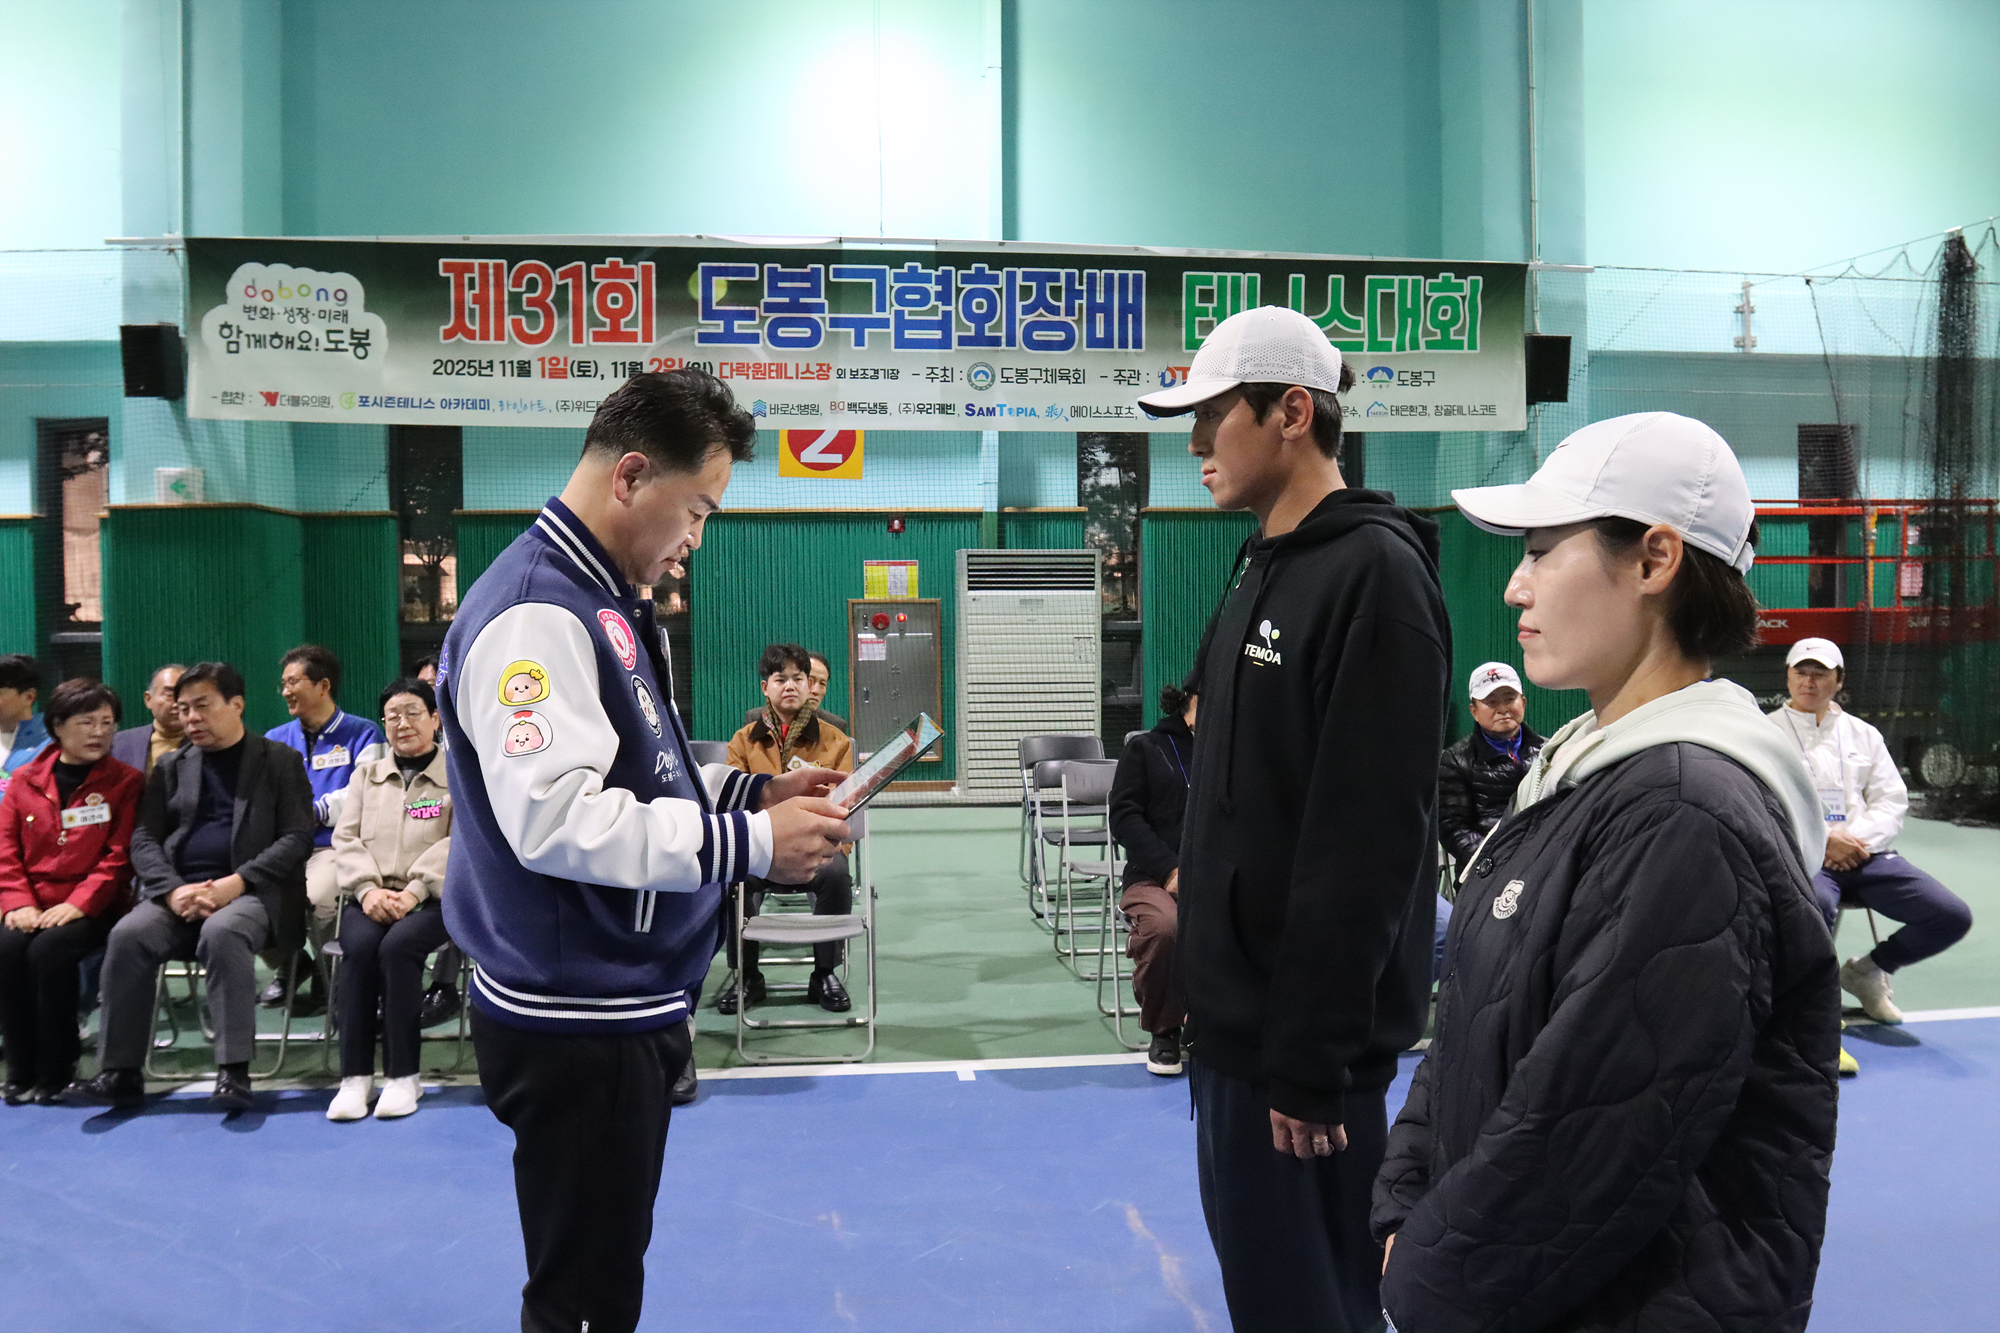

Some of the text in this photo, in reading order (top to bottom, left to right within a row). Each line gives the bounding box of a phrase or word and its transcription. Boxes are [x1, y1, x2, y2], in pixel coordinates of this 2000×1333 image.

[244, 278, 348, 307] dobong
[438, 257, 657, 347] 제31회
[695, 261, 1147, 353] 도봉구협회장배
[218, 321, 372, 360] 함께해요! 도봉
[432, 358, 494, 377] 2025년
[498, 359, 532, 378] 11월
[719, 362, 833, 380] 다락원테니스장
[835, 367, 847, 379] 외
[849, 367, 900, 380] 보조경기장
[925, 366, 954, 383] 주최
[1000, 367, 1086, 385] 도봉구체육회
[1112, 368, 1142, 386] 주관
[1396, 370, 1436, 387] 도봉구
[358, 395, 436, 410] 포시즌테니스
[800, 429, 843, 464] 2
[1244, 643, 1282, 665] TEMOA
